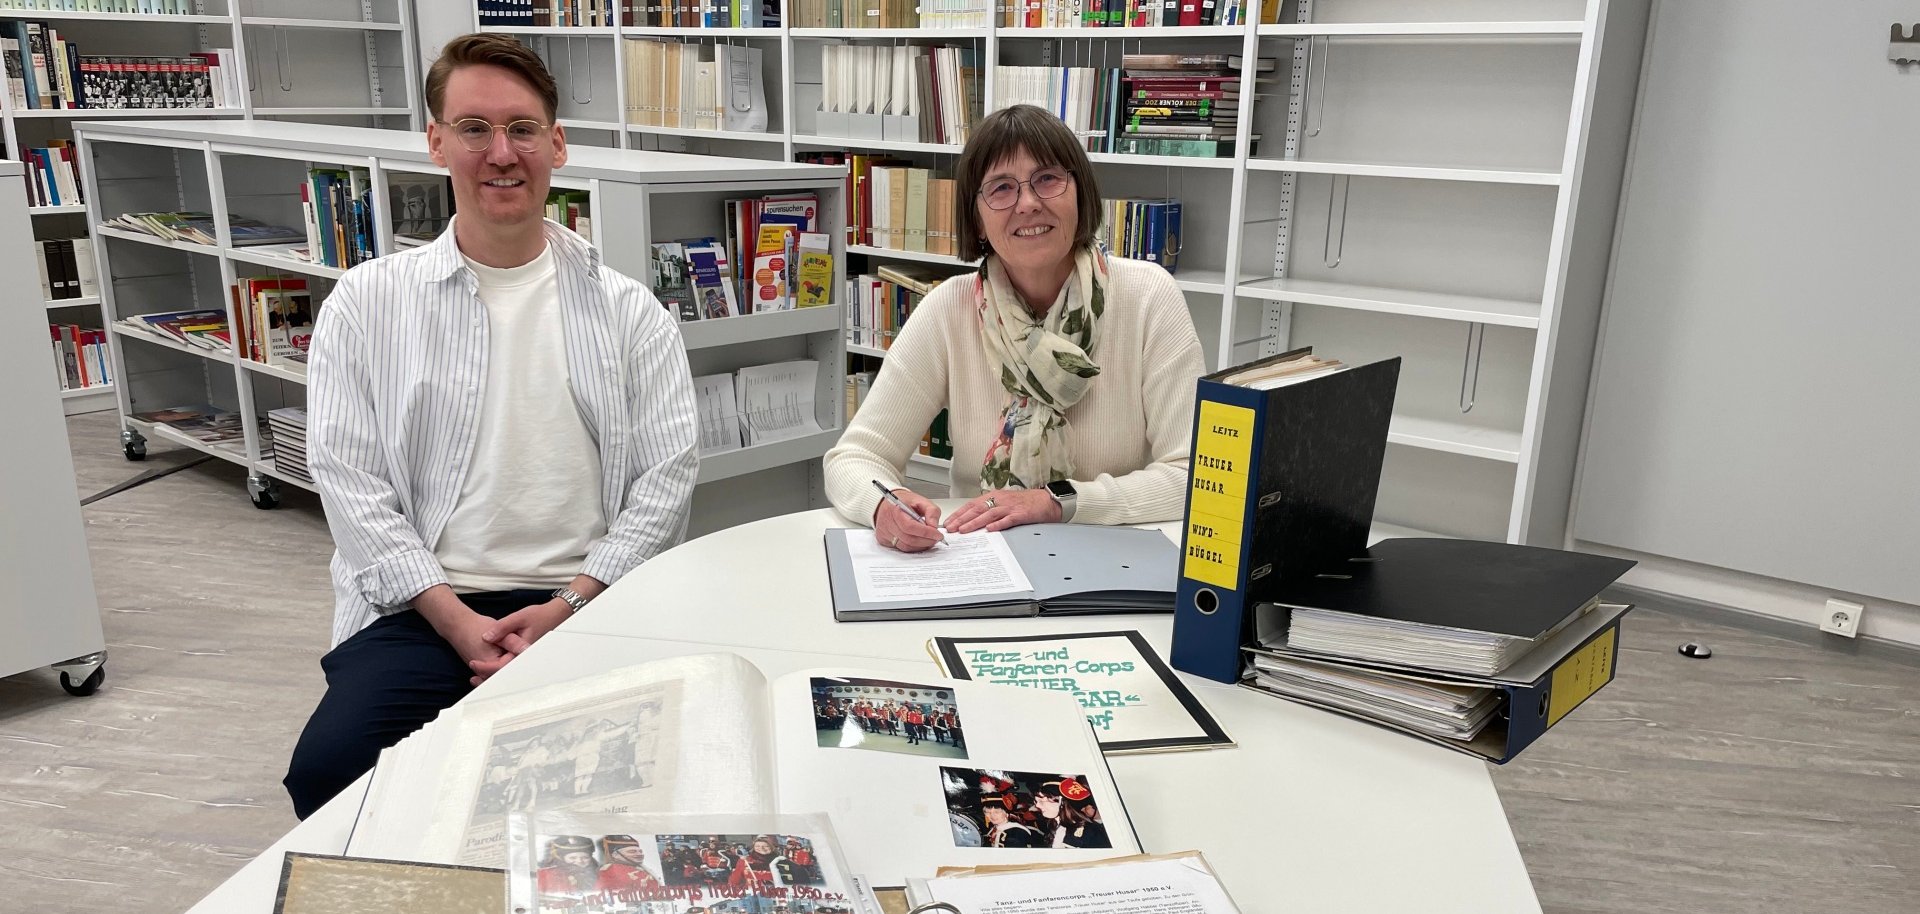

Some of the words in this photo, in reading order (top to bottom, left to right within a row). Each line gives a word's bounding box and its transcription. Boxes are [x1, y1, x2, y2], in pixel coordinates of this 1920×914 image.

[1144, 98, 1159, 106] ZOO
[1158, 99, 1184, 107] KÖLNER
[1212, 425, 1239, 438] LEITZ
[1198, 454, 1233, 472] TREUER
[1194, 477, 1225, 495] HUSAR
[1192, 523, 1219, 538] WIND-
[1189, 544, 1223, 564] BÜGGEL
[793, 884, 822, 900] 1950
[1033, 894, 1086, 903] Fanfarencorps
